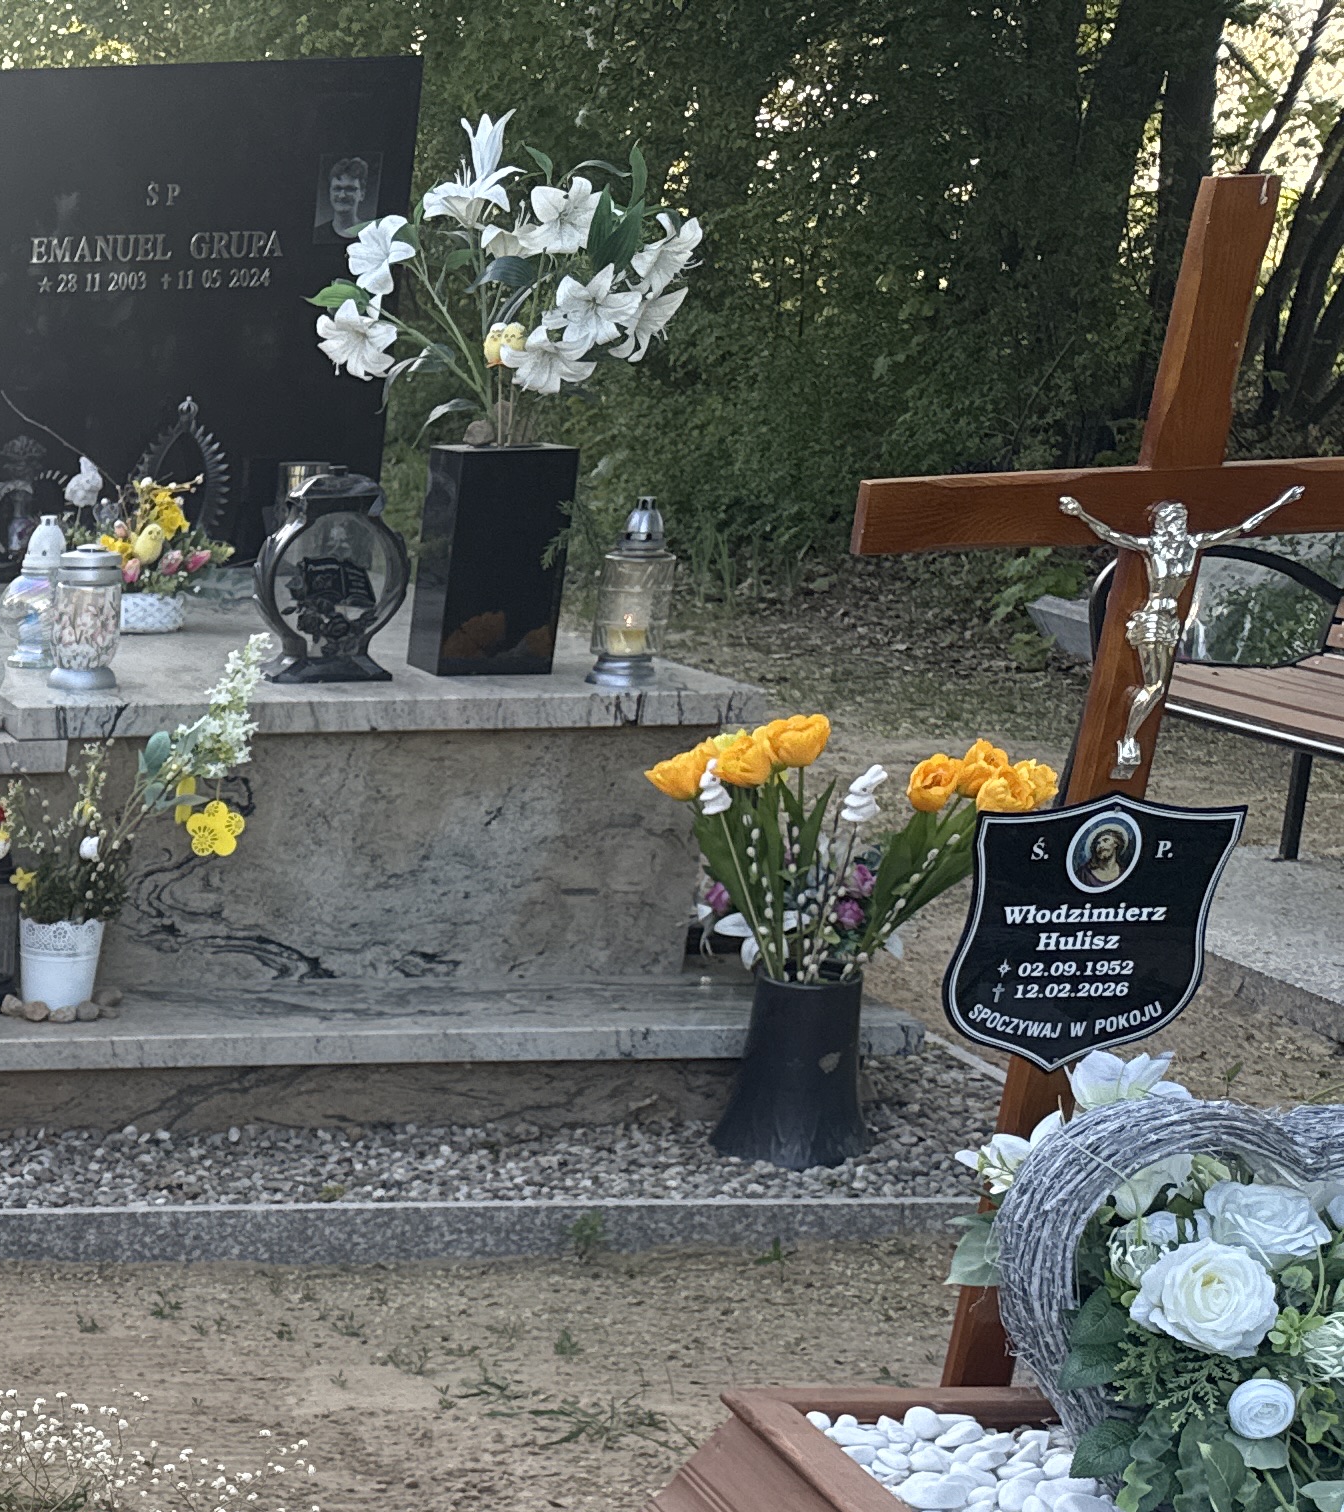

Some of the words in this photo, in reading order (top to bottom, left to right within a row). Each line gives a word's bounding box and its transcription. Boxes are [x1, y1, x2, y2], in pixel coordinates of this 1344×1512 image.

[29, 234, 172, 264] EMANUEL
[190, 230, 284, 259] GRUPA
[1030, 837, 1049, 860] Ś.
[1155, 840, 1173, 859] P.
[1003, 902, 1167, 925] Włodzimierz
[1036, 930, 1120, 951] Hulisz
[1017, 960, 1135, 978] 02.09.1952
[1014, 981, 1129, 999] 12.02.2026
[968, 1003, 1062, 1039] SPOCZYWAJ
[1070, 1022, 1087, 1038] W
[1094, 1001, 1163, 1035] POKOJU
